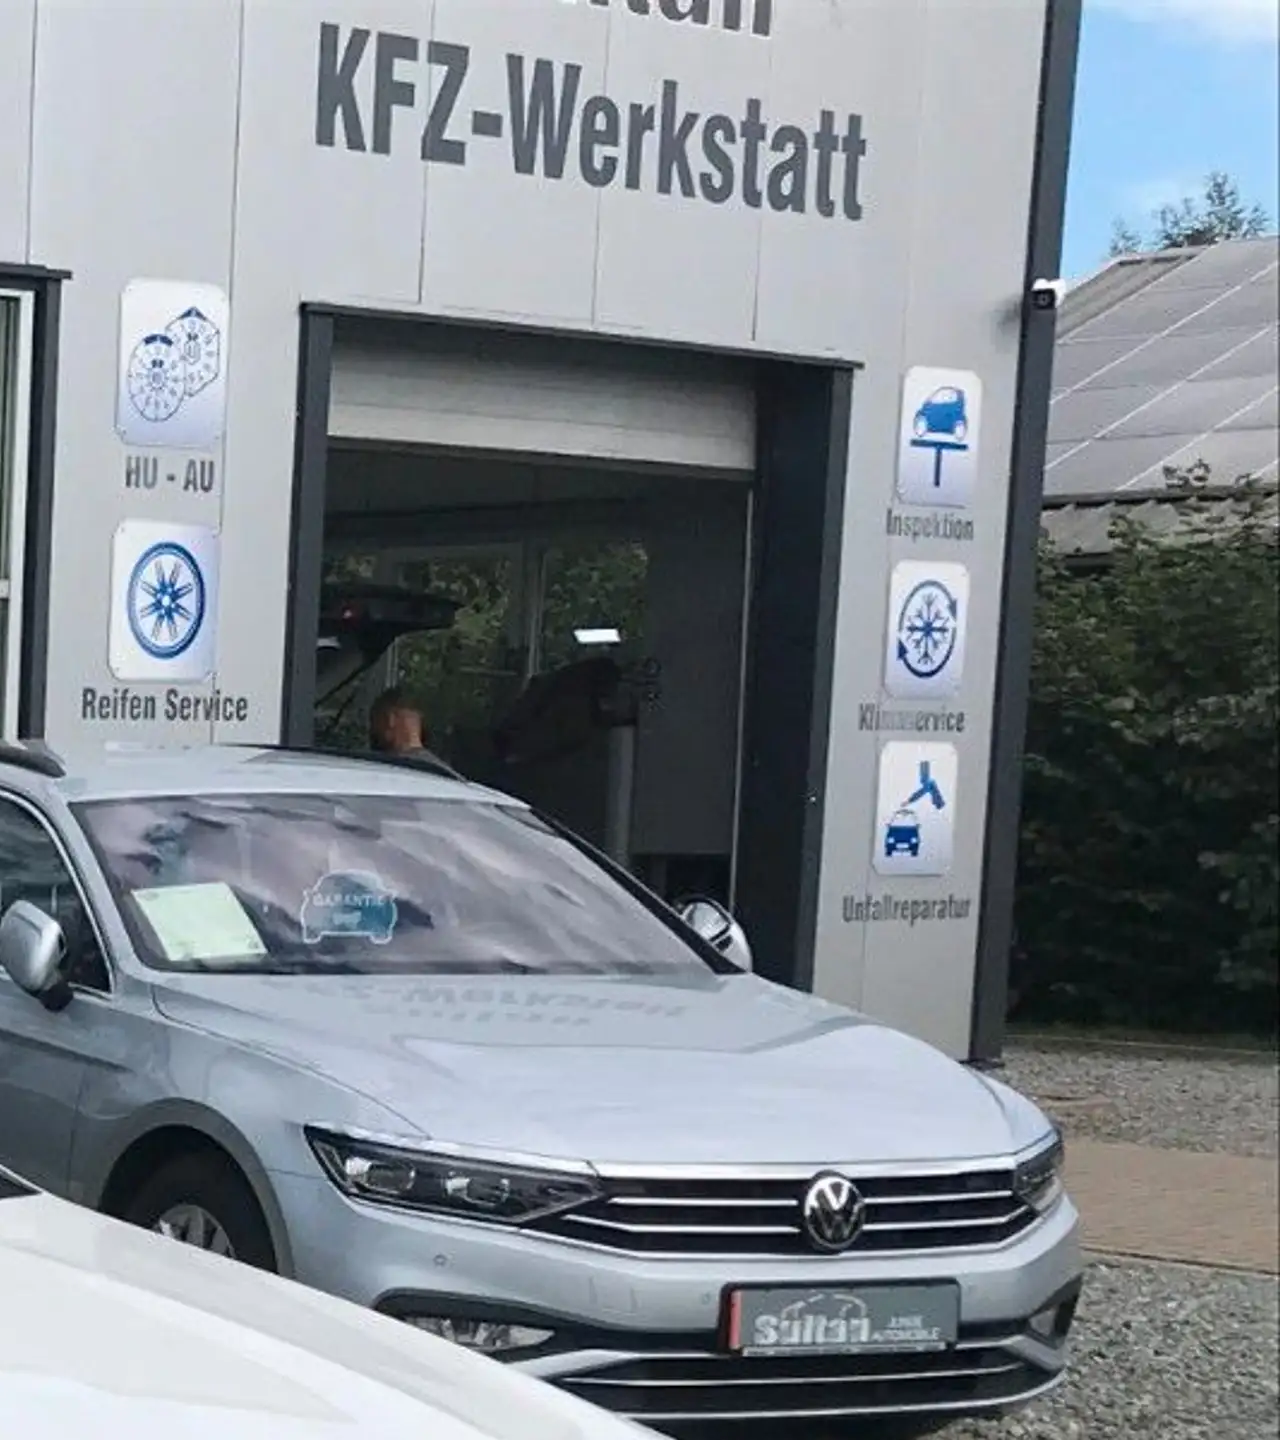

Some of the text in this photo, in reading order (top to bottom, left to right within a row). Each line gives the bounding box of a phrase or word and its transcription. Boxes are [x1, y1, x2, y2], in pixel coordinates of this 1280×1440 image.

[316, 22, 866, 221] KFZ-Werkstatt
[125, 456, 158, 490] HU
[183, 461, 214, 493] AU
[886, 509, 974, 541] Inspektion
[82, 688, 248, 721] Reifen Service
[842, 895, 972, 928] Unfallreparatur
